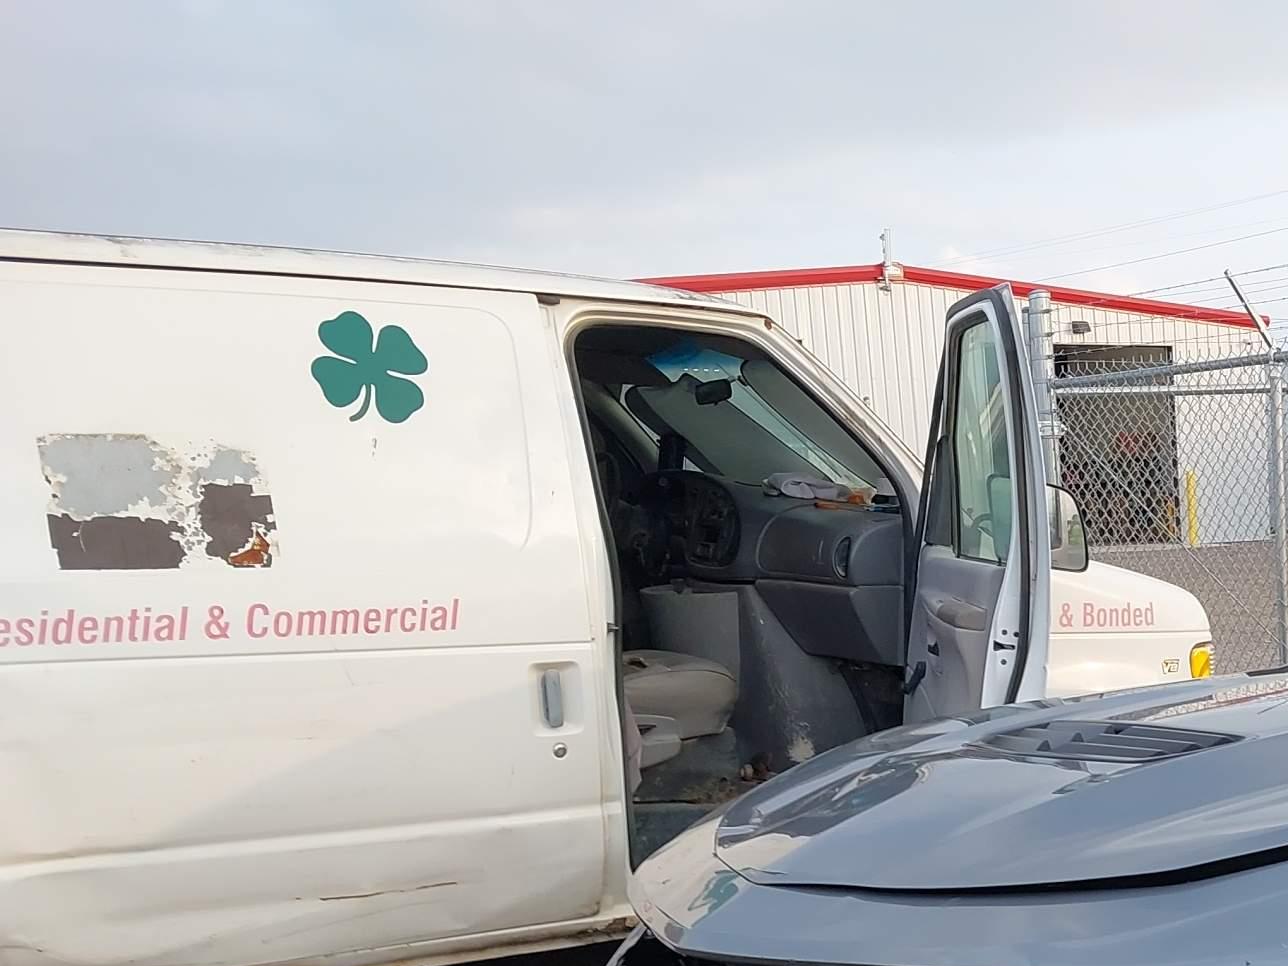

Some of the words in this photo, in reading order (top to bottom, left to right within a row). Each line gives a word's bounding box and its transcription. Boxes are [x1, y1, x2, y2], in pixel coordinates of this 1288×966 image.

[0, 606, 189, 646] esidential
[204, 604, 231, 640] &
[245, 598, 460, 638] Commercial
[1059, 602, 1073, 627] &
[1082, 602, 1155, 627] Bonded
[1161, 659, 1180, 674] V8
